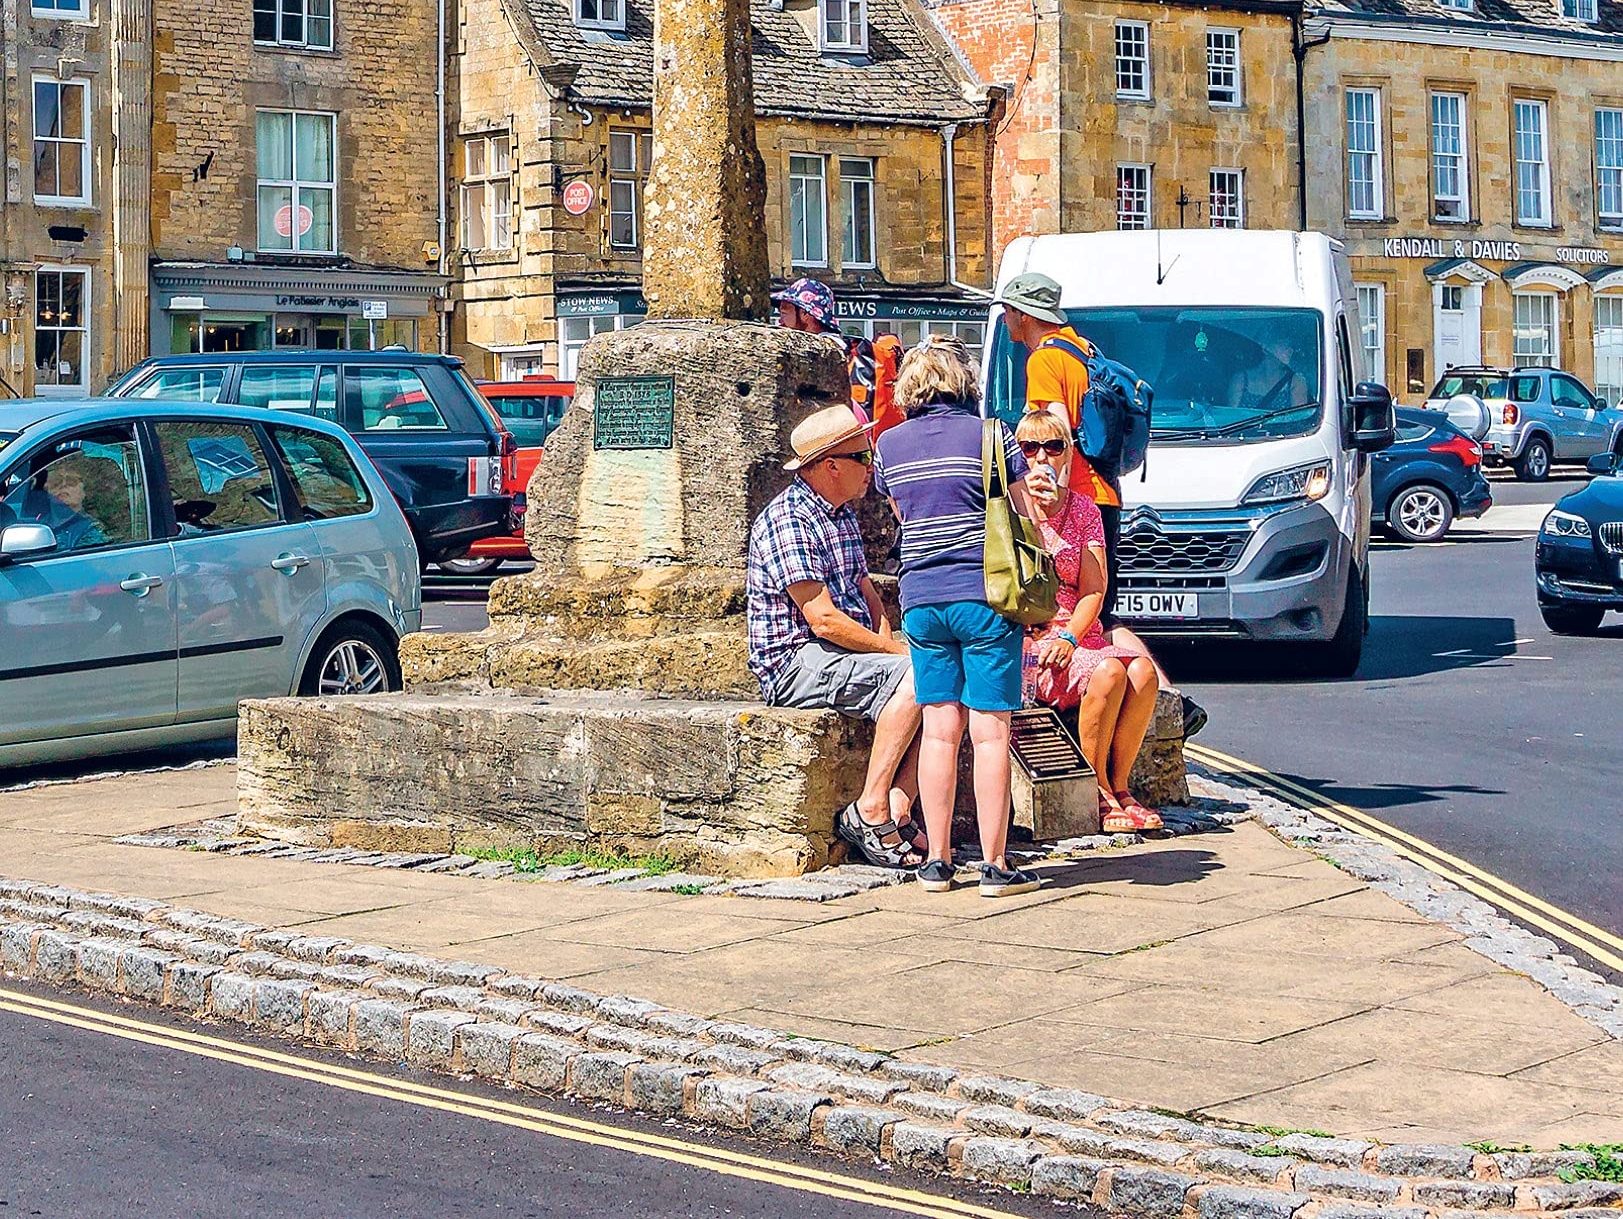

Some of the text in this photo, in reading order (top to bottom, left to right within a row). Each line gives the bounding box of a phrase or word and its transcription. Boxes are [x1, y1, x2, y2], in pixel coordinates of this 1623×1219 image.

[570, 188, 585, 197] POST
[567, 196, 587, 206] OFFICE
[1383, 238, 1521, 261] KENDALL & DAVIES
[1556, 247, 1609, 264] SOLICITORS
[276, 295, 288, 306] Le
[327, 296, 360, 309] Anglais
[560, 296, 614, 307] STOW NEWS
[832, 301, 877, 317] EWS
[892, 306, 906, 315] Post
[908, 306, 931, 316] Office
[937, 308, 957, 317] Maps
[1115, 595, 1185, 612] F15 OWV
